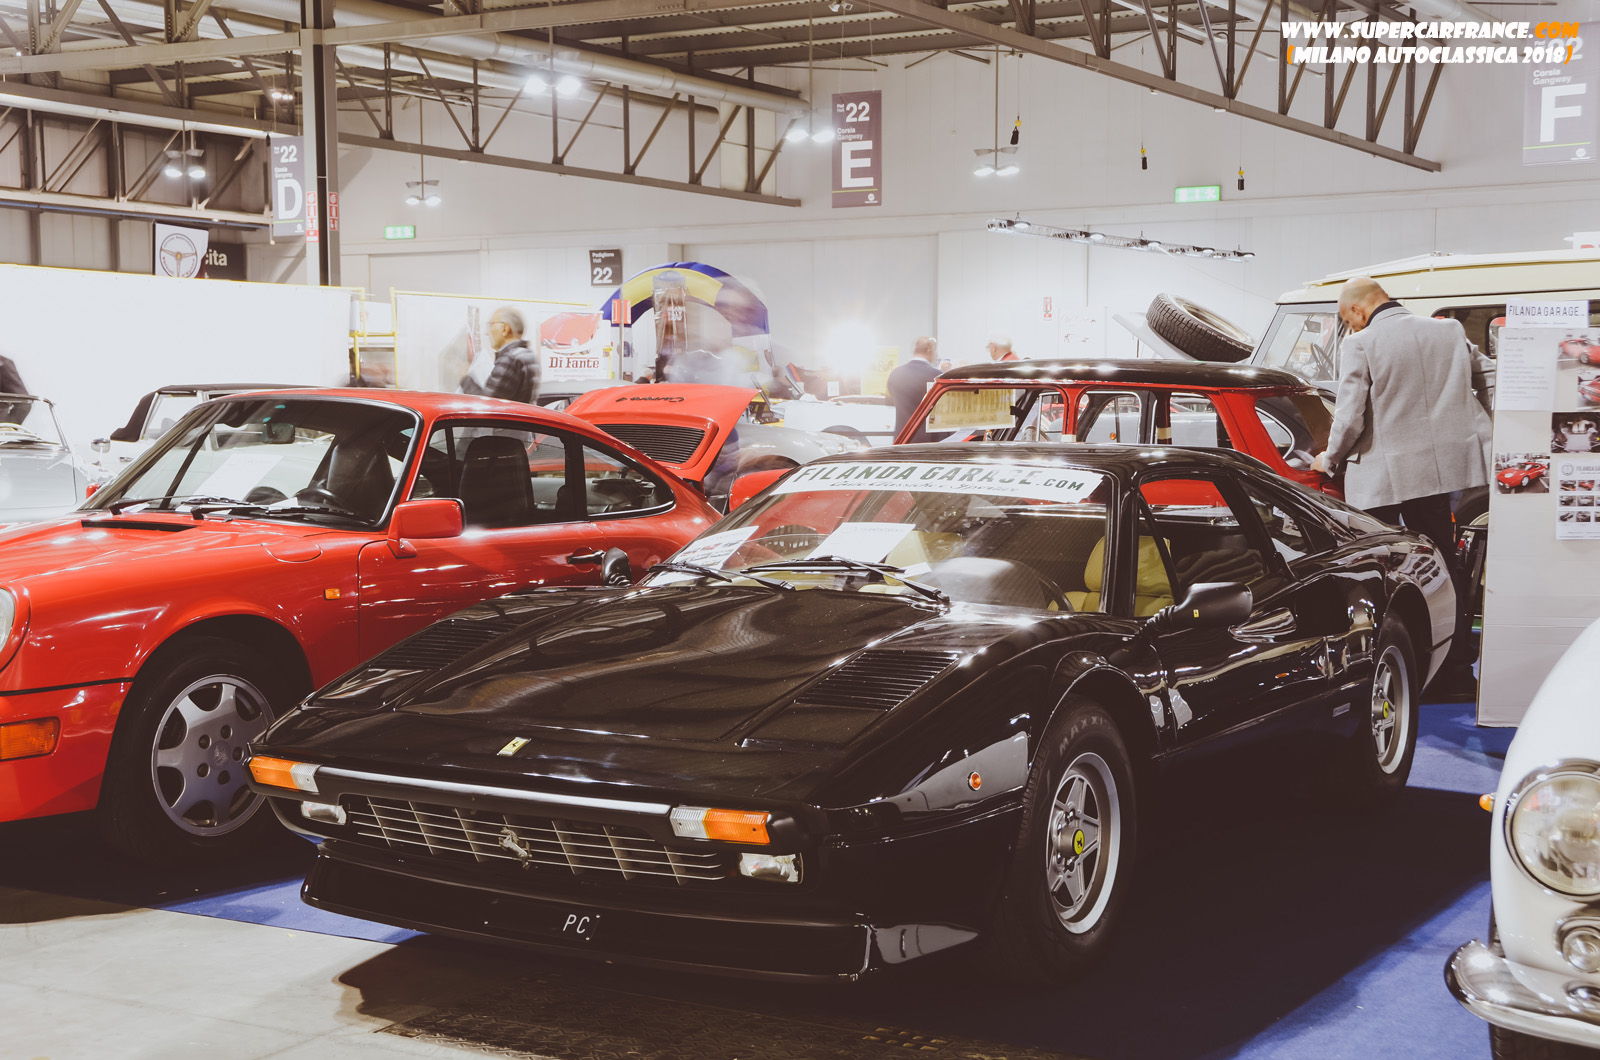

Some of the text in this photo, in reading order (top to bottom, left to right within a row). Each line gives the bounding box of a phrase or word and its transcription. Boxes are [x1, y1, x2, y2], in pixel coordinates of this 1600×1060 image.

[1533, 68, 1561, 77] Corsia
[1533, 75, 1571, 86] Gangway
[845, 101, 870, 123] 22
[1539, 83, 1586, 143] F
[280, 144, 297, 163] 22
[841, 140, 874, 188] E
[277, 178, 303, 220] D
[593, 266, 613, 284] 22
[1508, 305, 1542, 316] FILANDA
[549, 356, 600, 369] Di Fante
[793, 464, 919, 483] FILANDA
[1059, 715, 1111, 757] MAXXIS
[562, 913, 590, 934] PC
